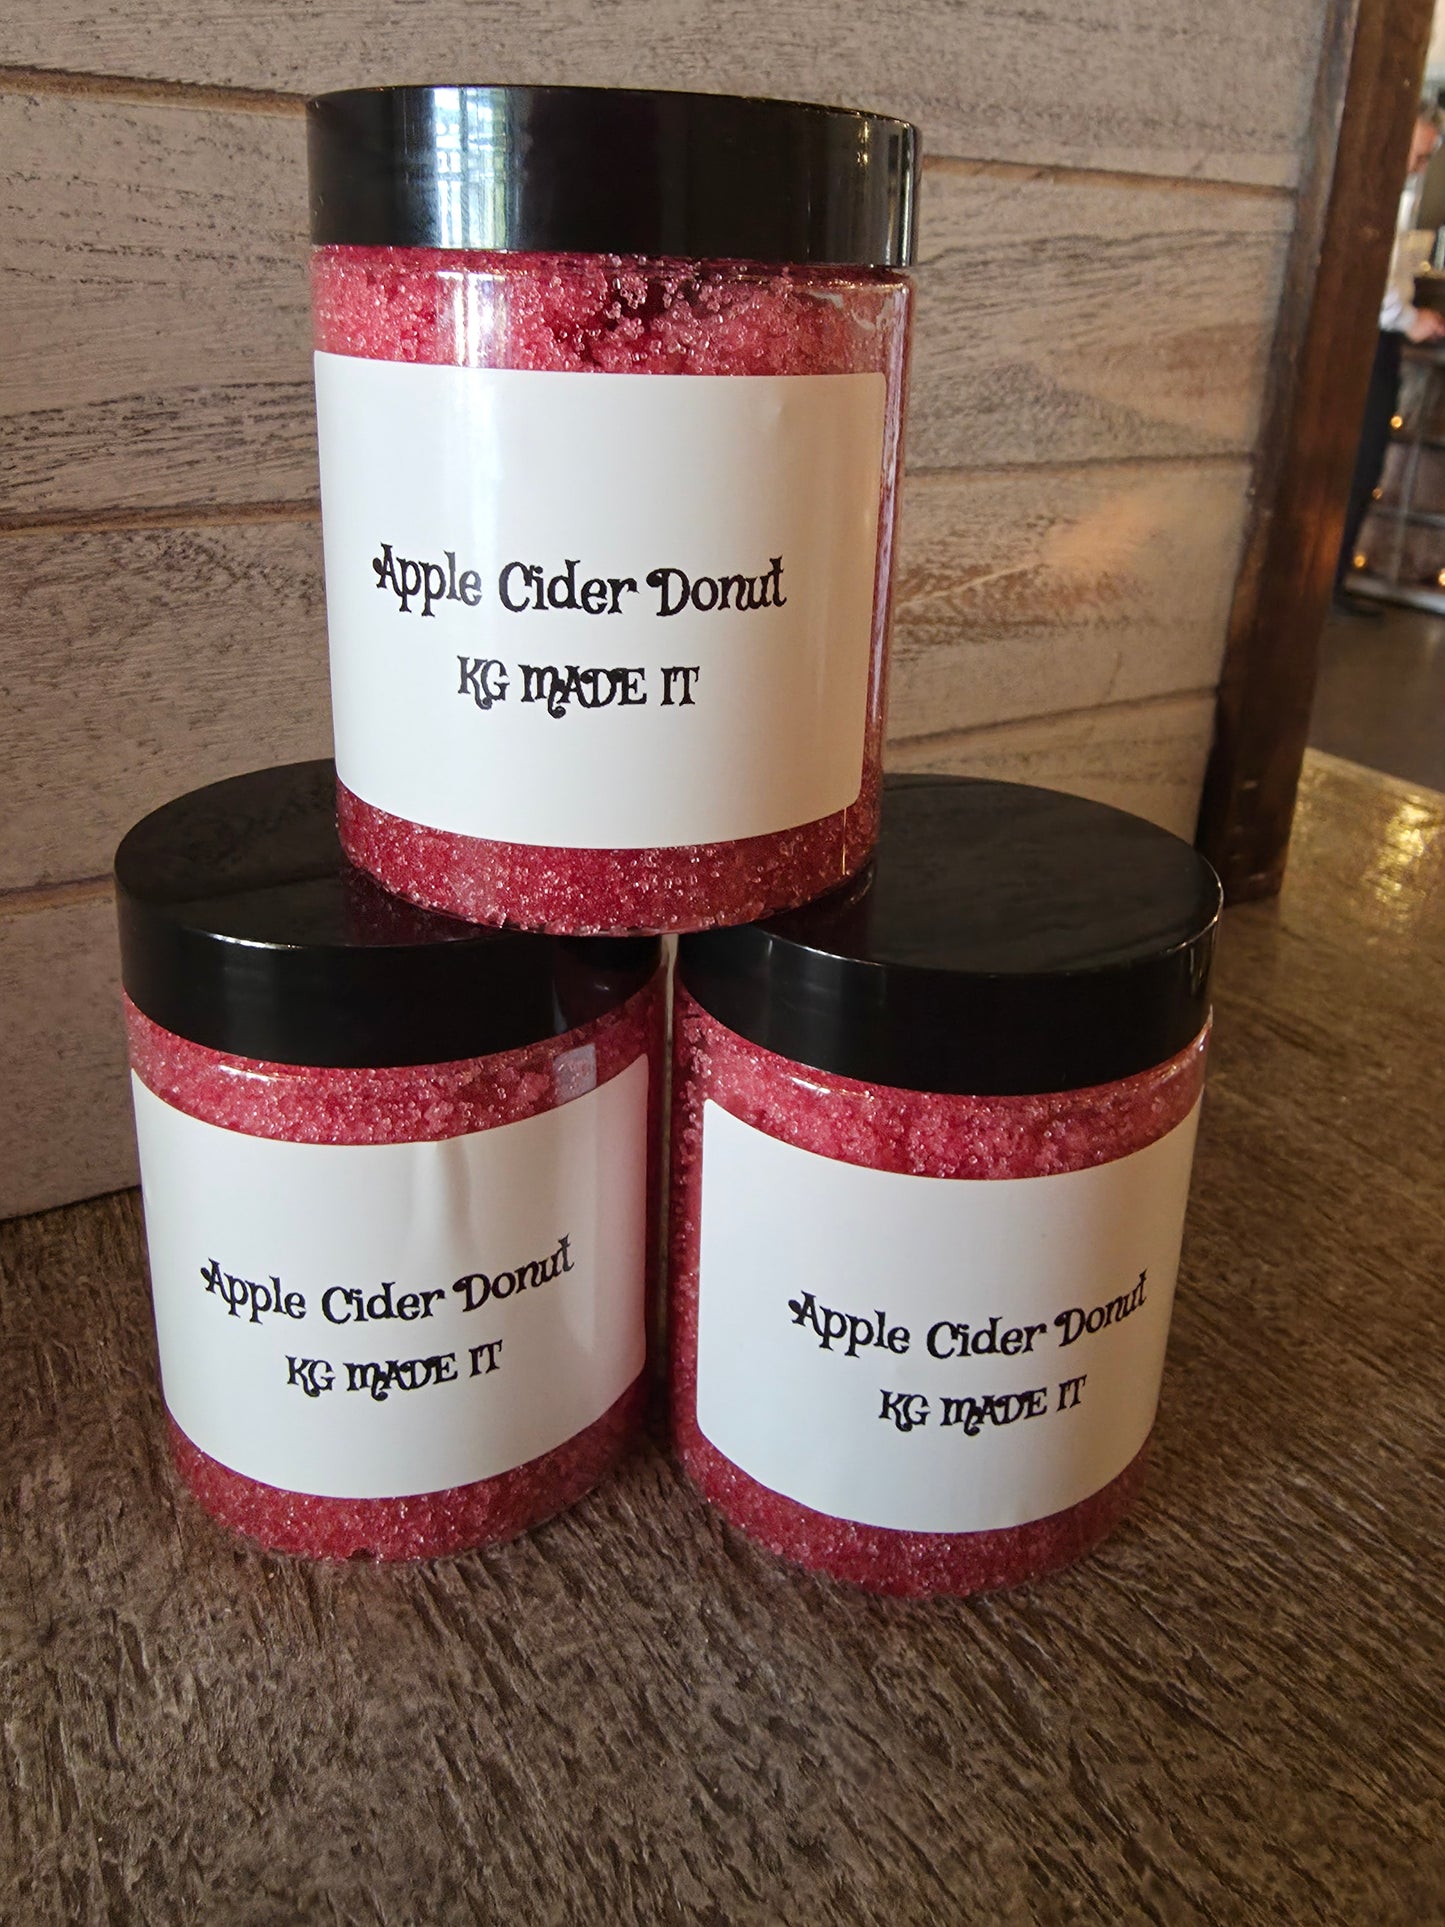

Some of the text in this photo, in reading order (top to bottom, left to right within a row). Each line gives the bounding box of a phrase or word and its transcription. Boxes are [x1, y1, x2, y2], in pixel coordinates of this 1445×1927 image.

[373, 543, 787, 618] Apple Cider Donut
[457, 655, 700, 719] KG MADE IT
[200, 1233, 575, 1324] Apple Cider Donut
[788, 1269, 1148, 1359] Apple Cider Donut
[285, 1340, 503, 1401] KG MADE IT
[879, 1375, 1087, 1436] KG MADE IT
